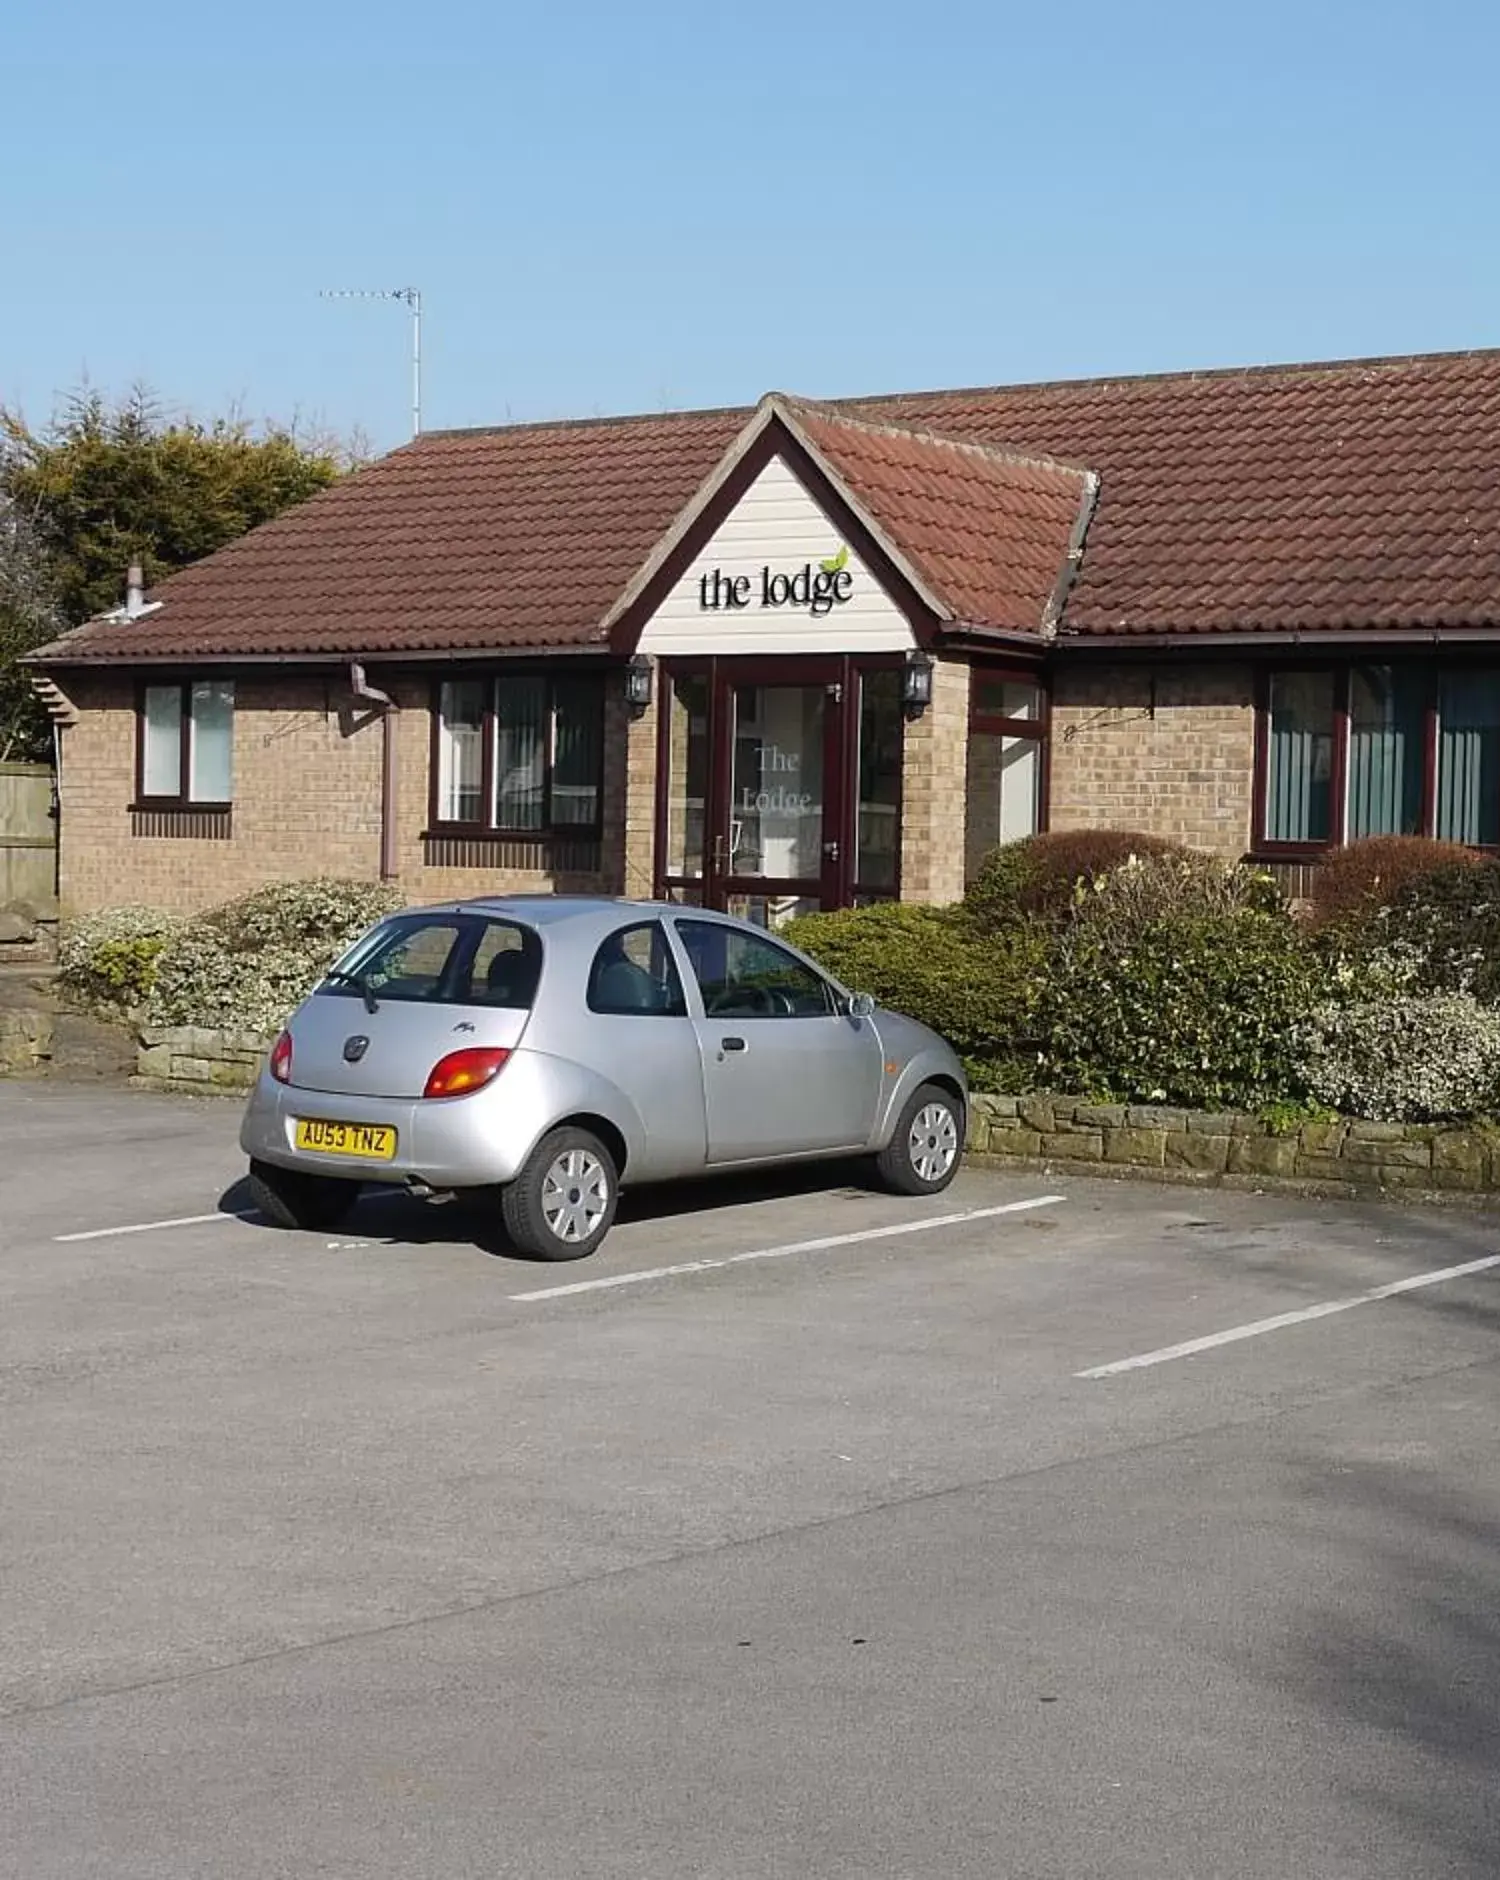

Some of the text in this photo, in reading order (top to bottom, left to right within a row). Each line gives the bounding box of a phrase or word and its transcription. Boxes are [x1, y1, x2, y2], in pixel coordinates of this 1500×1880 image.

[699, 563, 853, 616] the lodge
[754, 744, 800, 771] The
[741, 785, 812, 818] Lodge
[303, 1122, 387, 1151] AU53 TNZ
